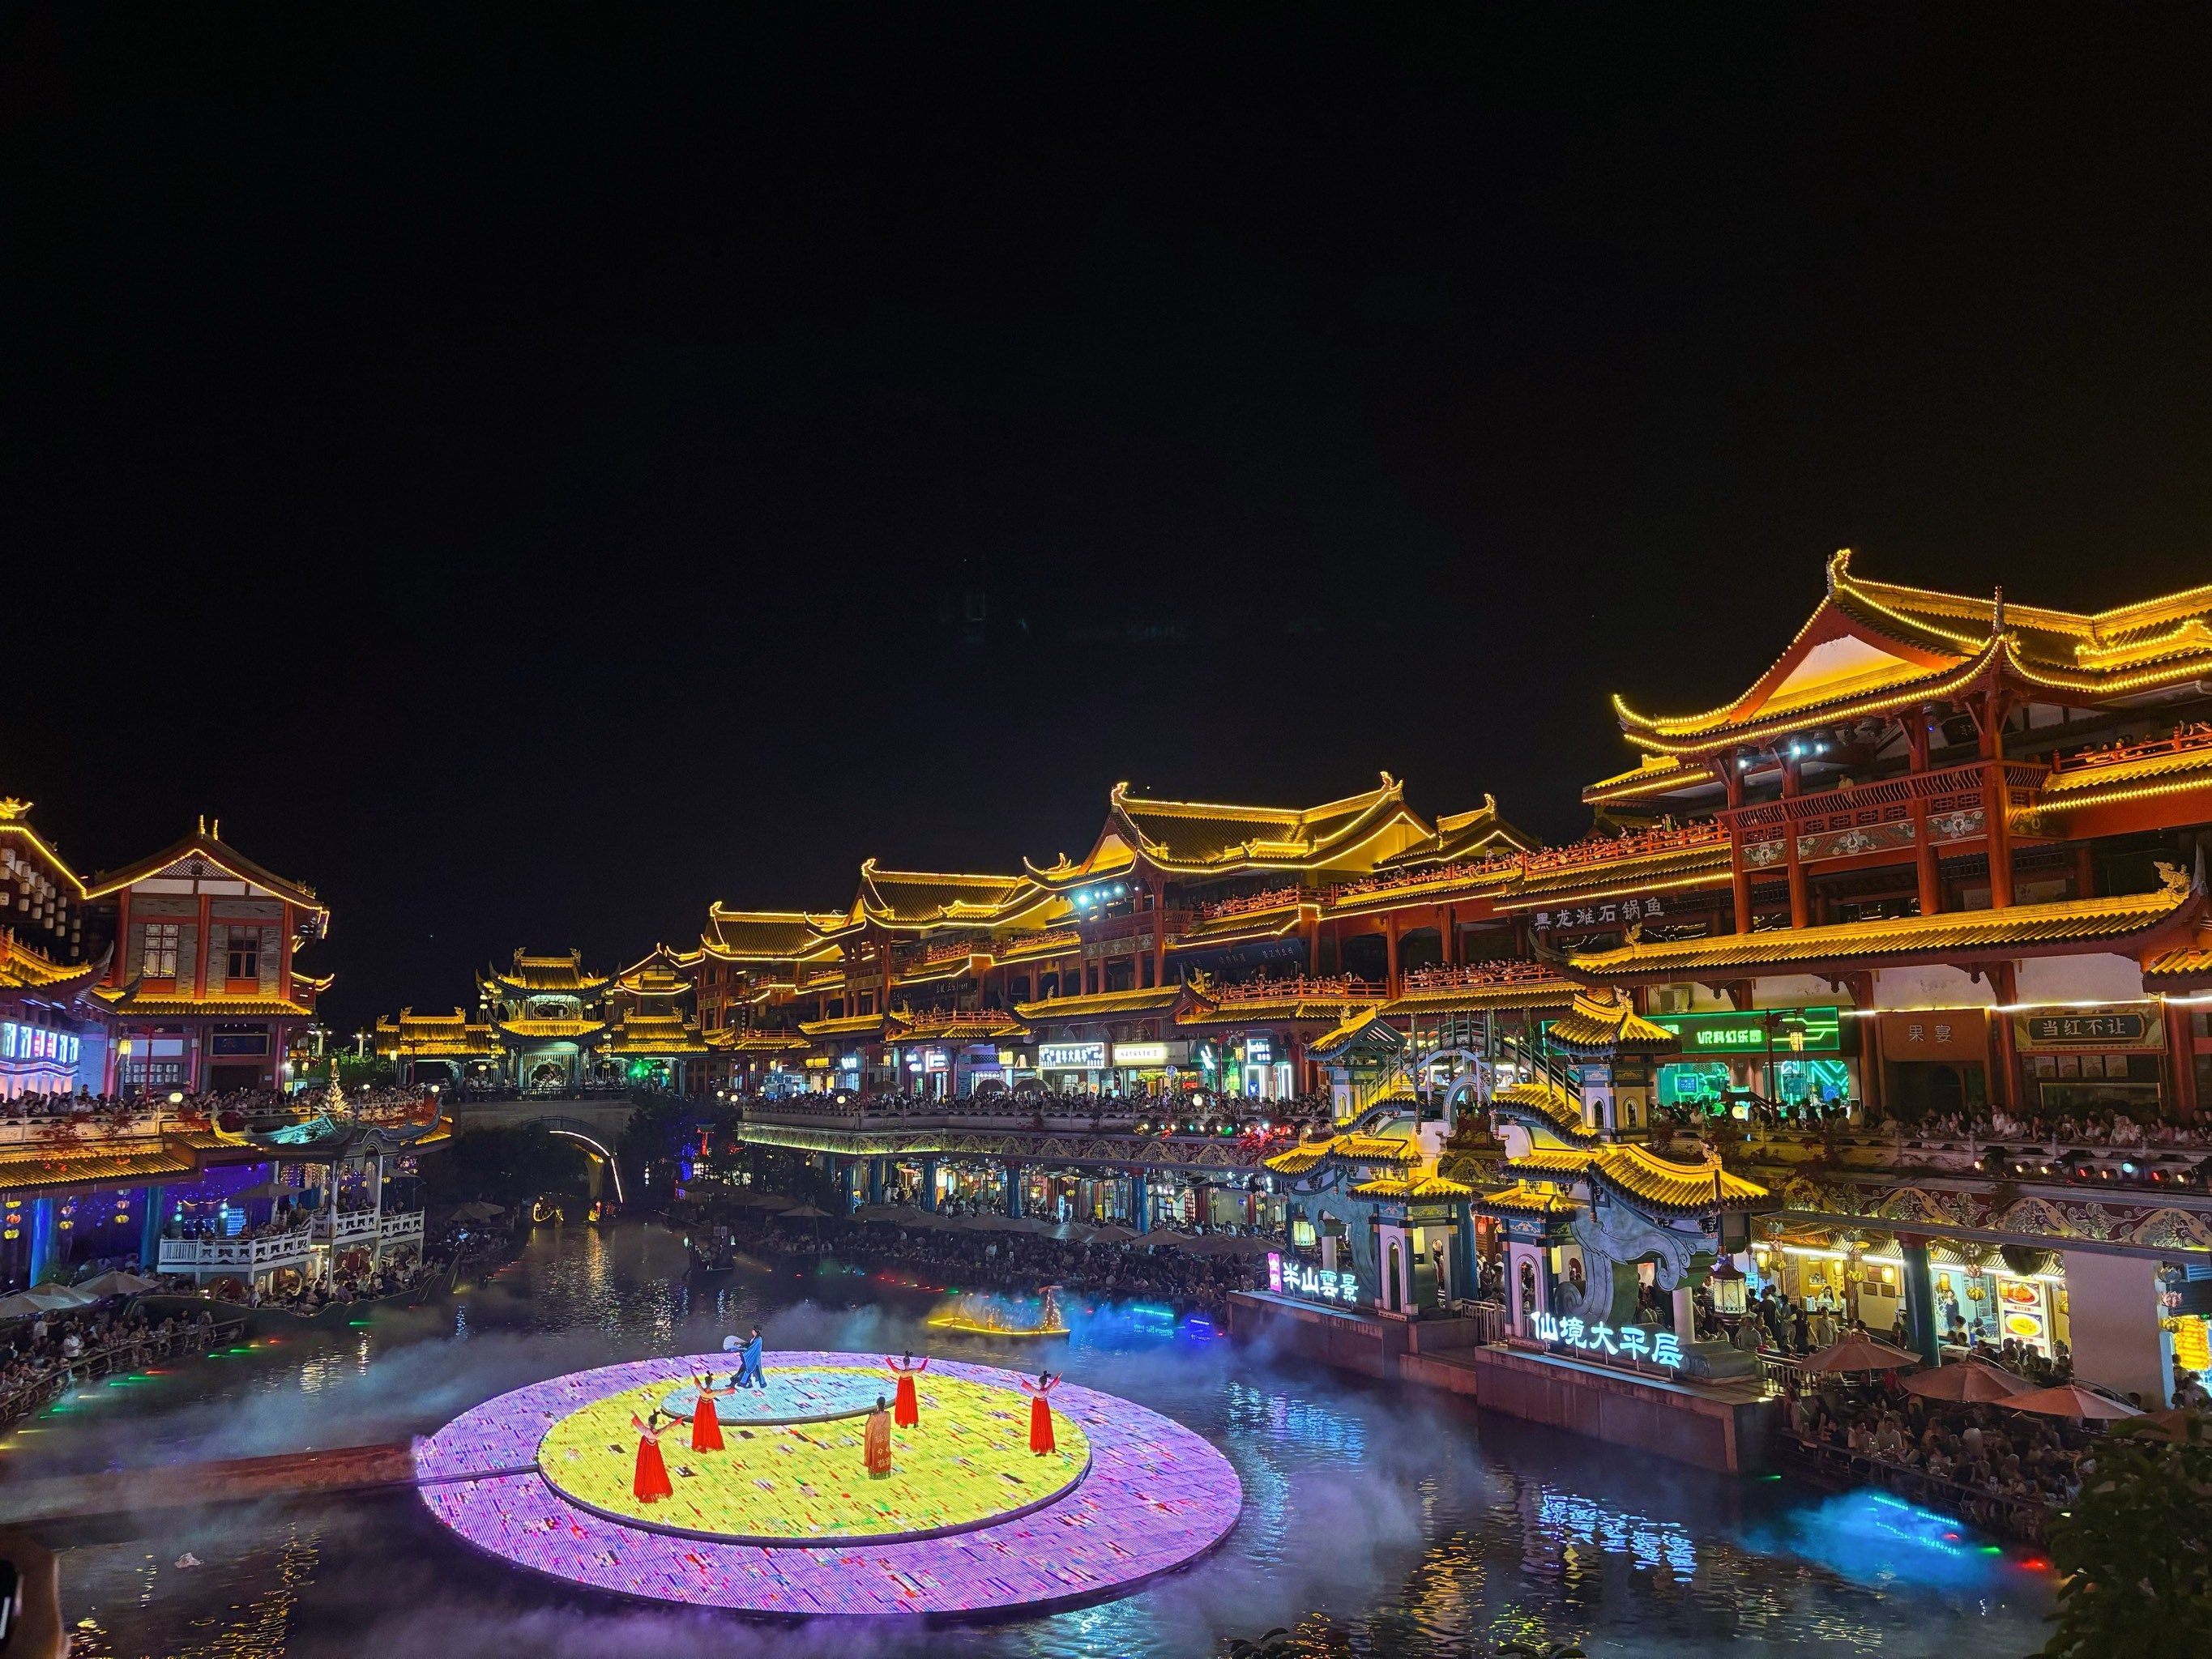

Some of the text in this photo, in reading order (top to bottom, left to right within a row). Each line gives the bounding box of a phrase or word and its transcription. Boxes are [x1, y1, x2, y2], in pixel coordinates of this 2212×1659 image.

[1908, 1025, 1952, 1043] 果宴
[2043, 1017, 2126, 1037] 当红不让
[1531, 1311, 1683, 1369] 仙境大平层
